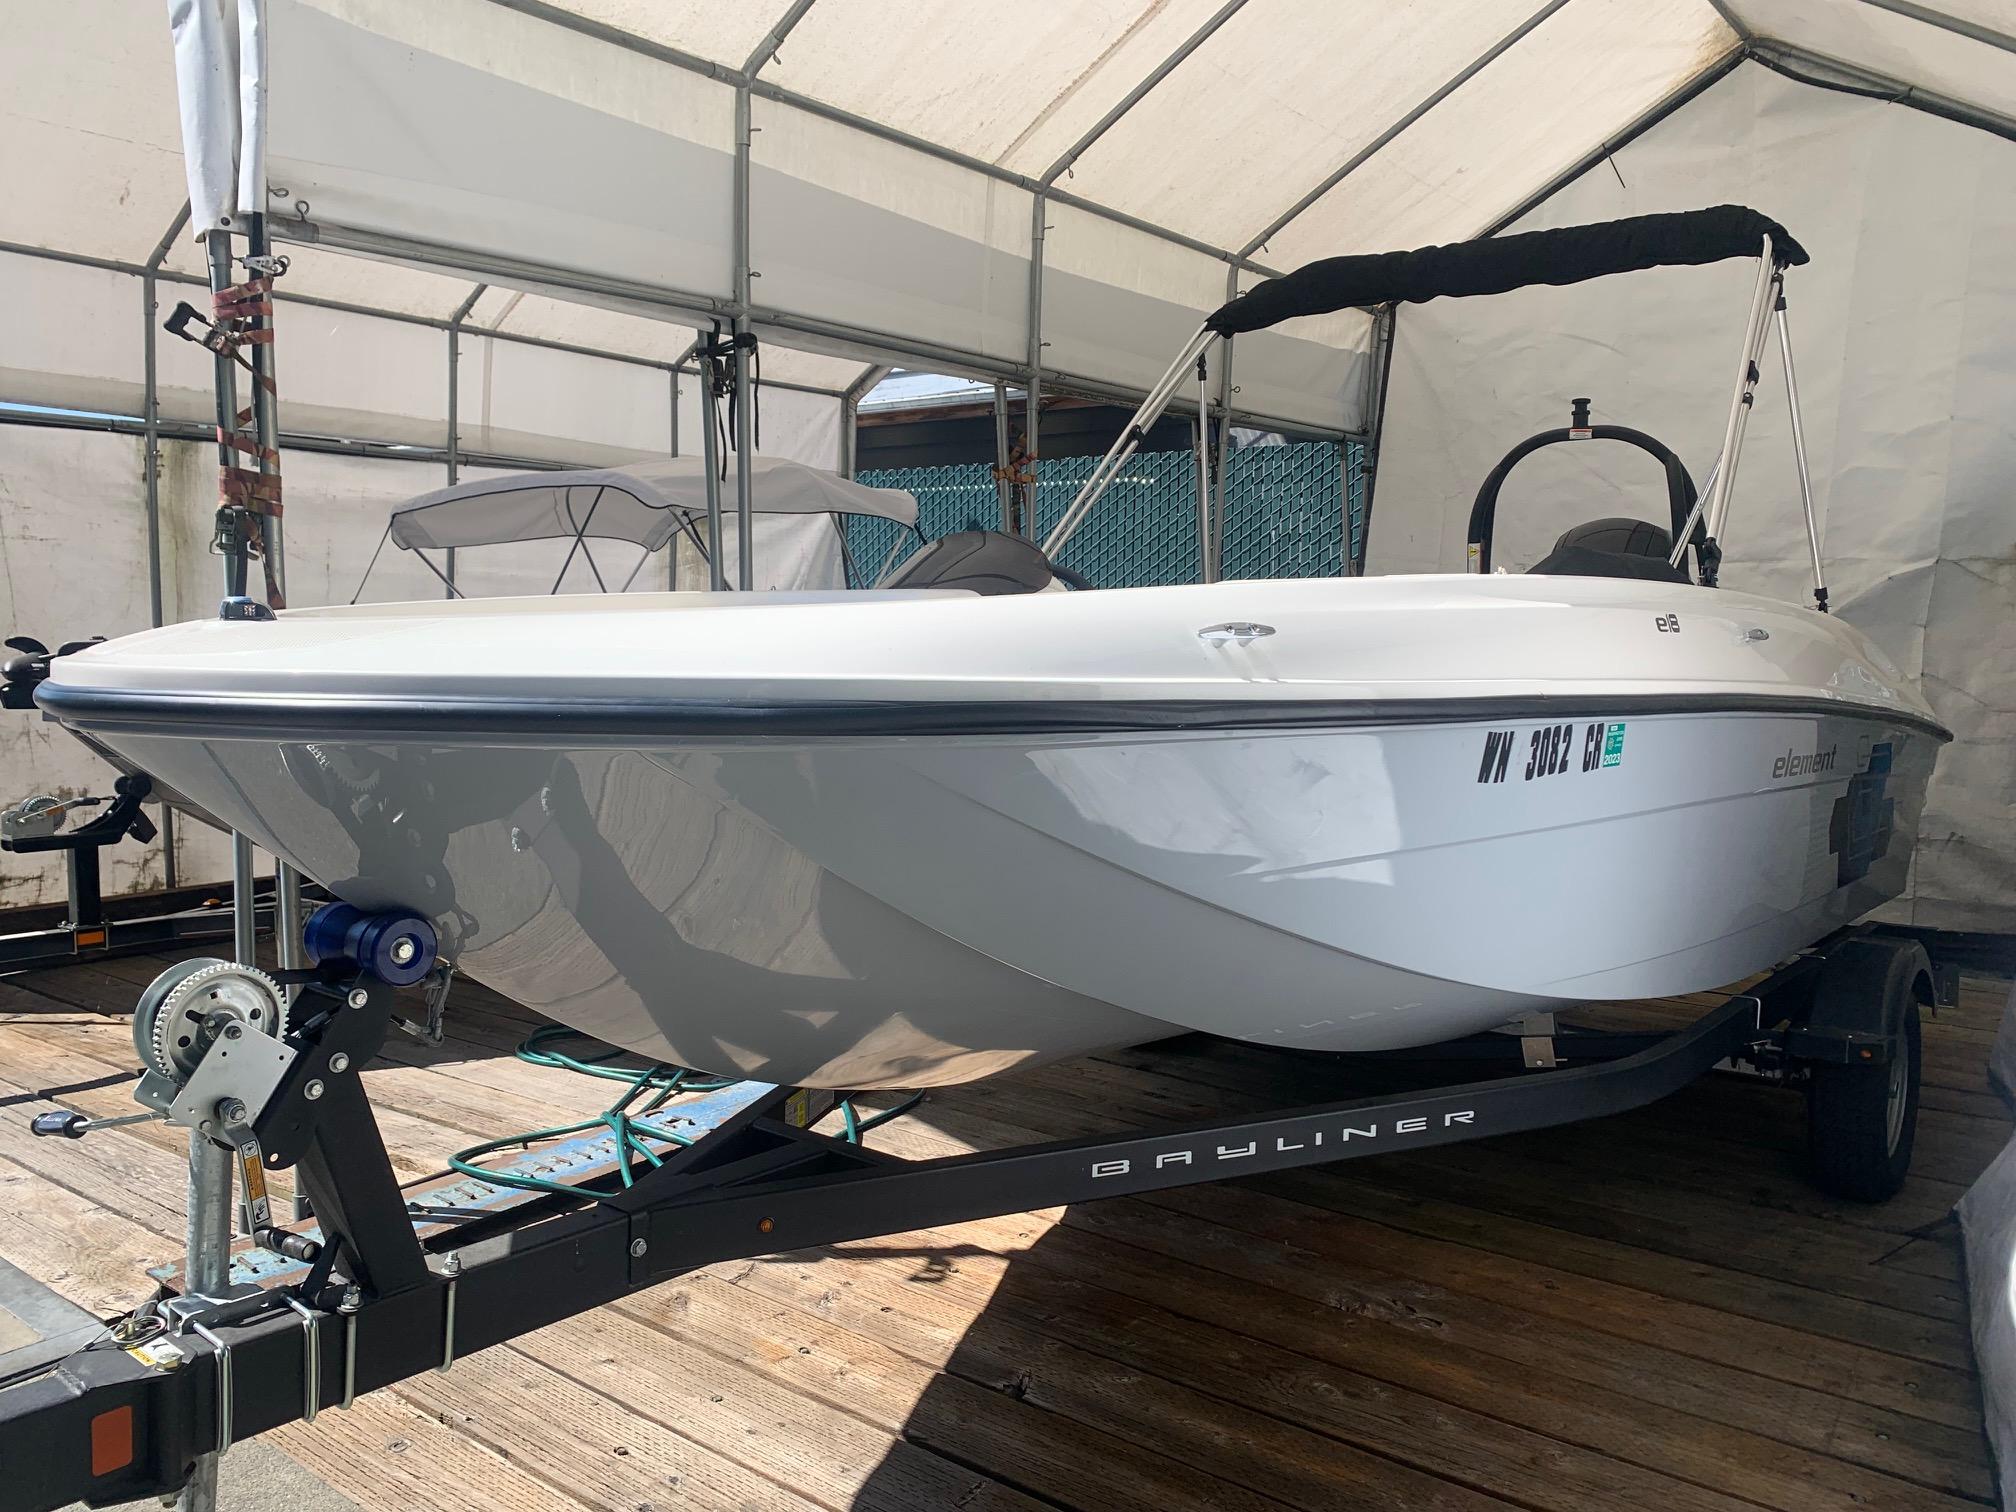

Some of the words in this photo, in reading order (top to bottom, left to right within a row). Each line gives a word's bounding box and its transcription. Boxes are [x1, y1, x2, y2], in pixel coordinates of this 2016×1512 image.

[1477, 731, 1515, 783] WN
[1525, 723, 1573, 781] 3082
[1582, 722, 1605, 773] CR
[1772, 744, 1837, 779] element
[1091, 1110, 1475, 1178] BAYLINER
